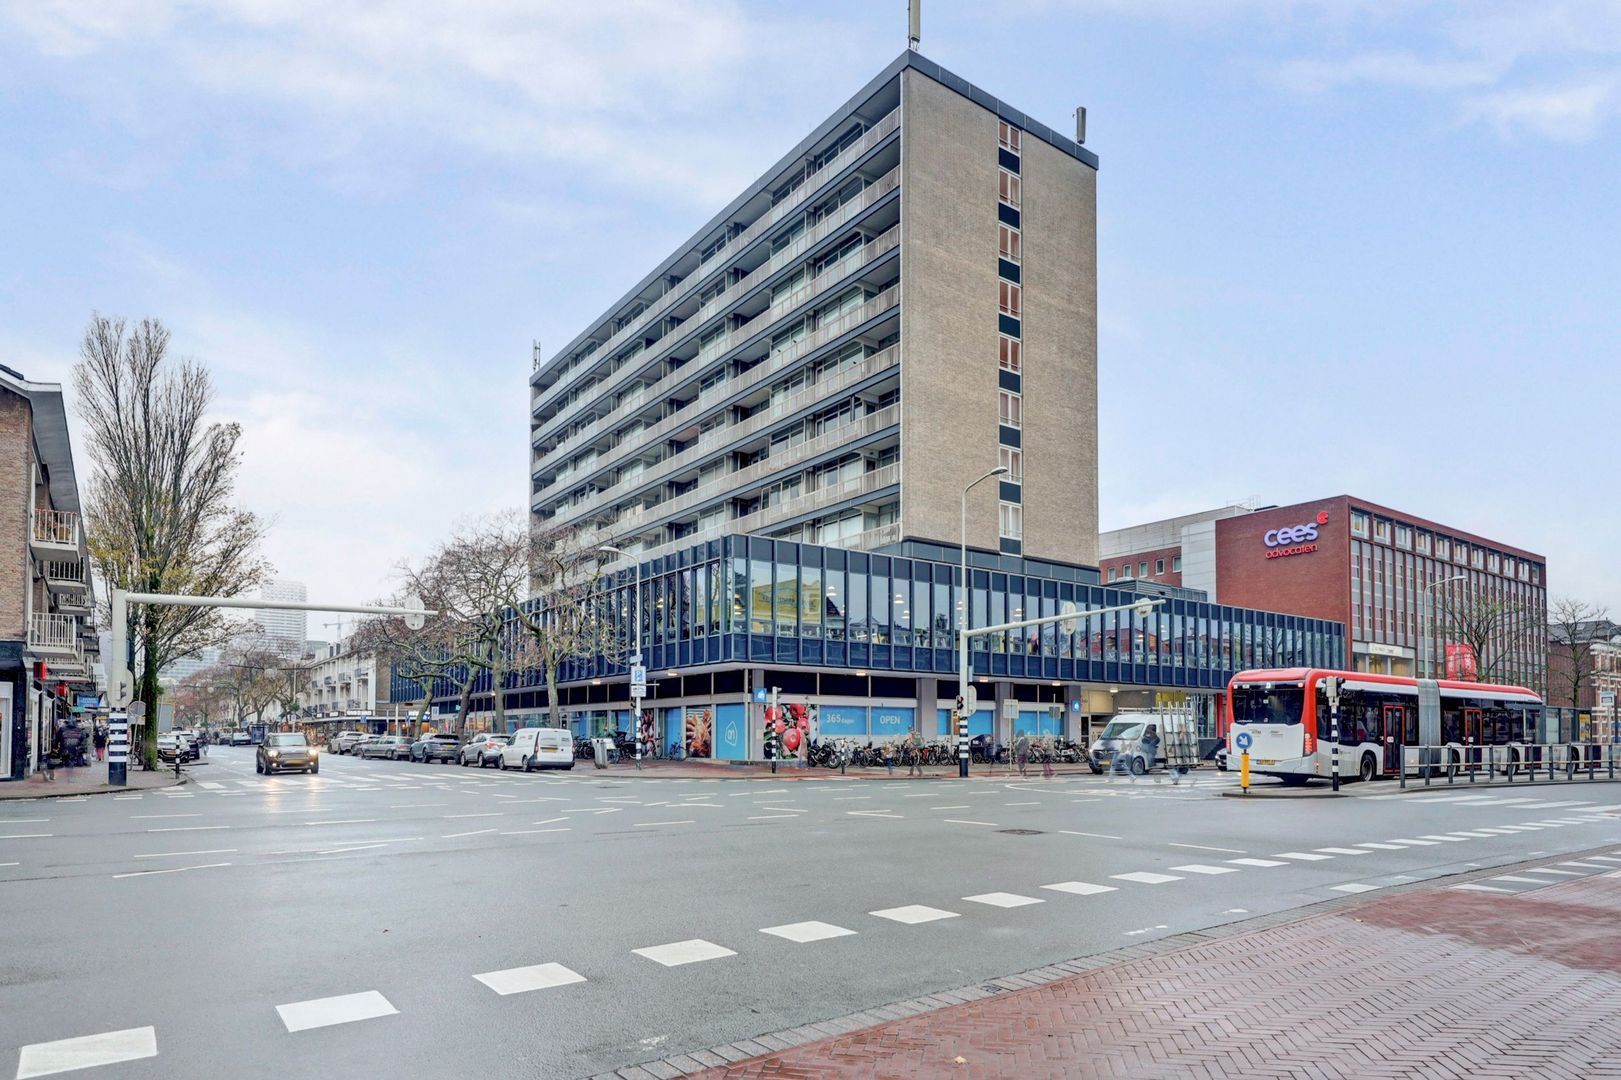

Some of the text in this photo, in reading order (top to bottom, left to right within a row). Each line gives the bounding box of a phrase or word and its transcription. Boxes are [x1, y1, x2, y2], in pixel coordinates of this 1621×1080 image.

[1264, 523, 1318, 547] cees
[1265, 544, 1318, 559] advocaten
[826, 713, 841, 724] 365
[880, 715, 901, 725] OPEN
